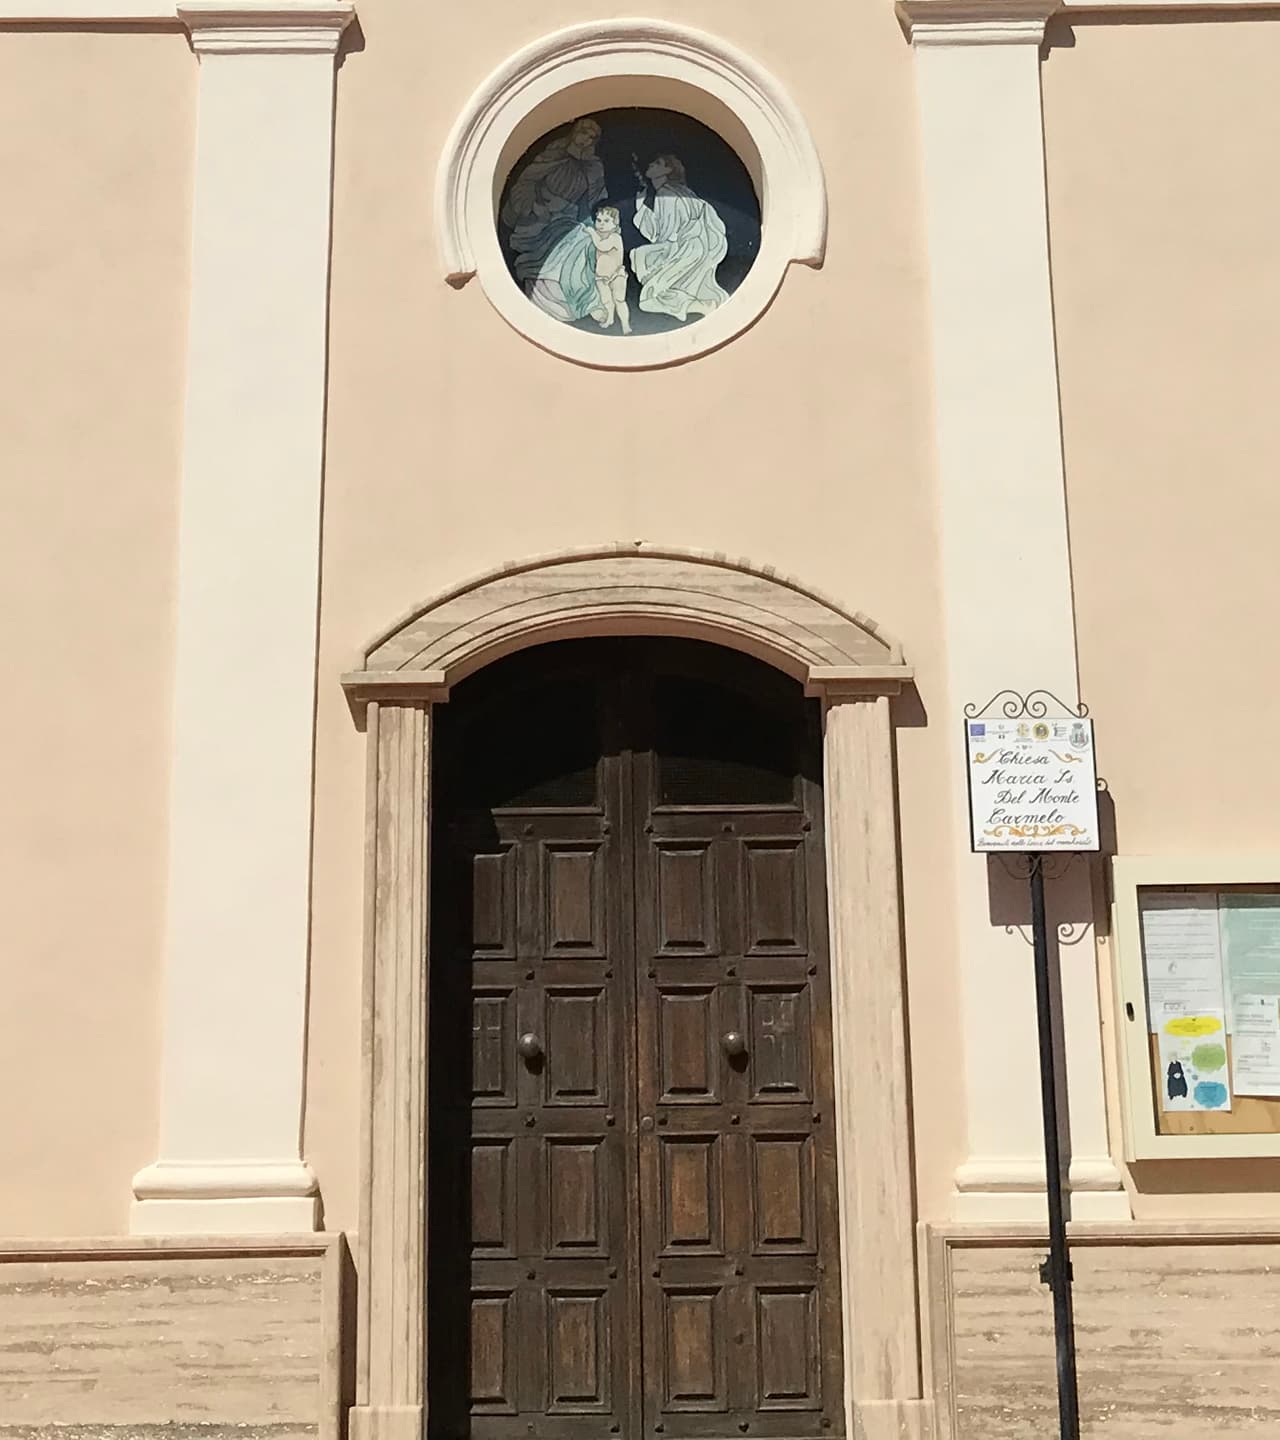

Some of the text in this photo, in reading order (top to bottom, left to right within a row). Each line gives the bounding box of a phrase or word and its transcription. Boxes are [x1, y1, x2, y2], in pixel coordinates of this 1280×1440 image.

[999, 749, 1050, 764] Chiesa
[982, 769, 1046, 785] Maria
[994, 787, 1080, 804] Del Monte
[986, 808, 1064, 824] Carmelo
